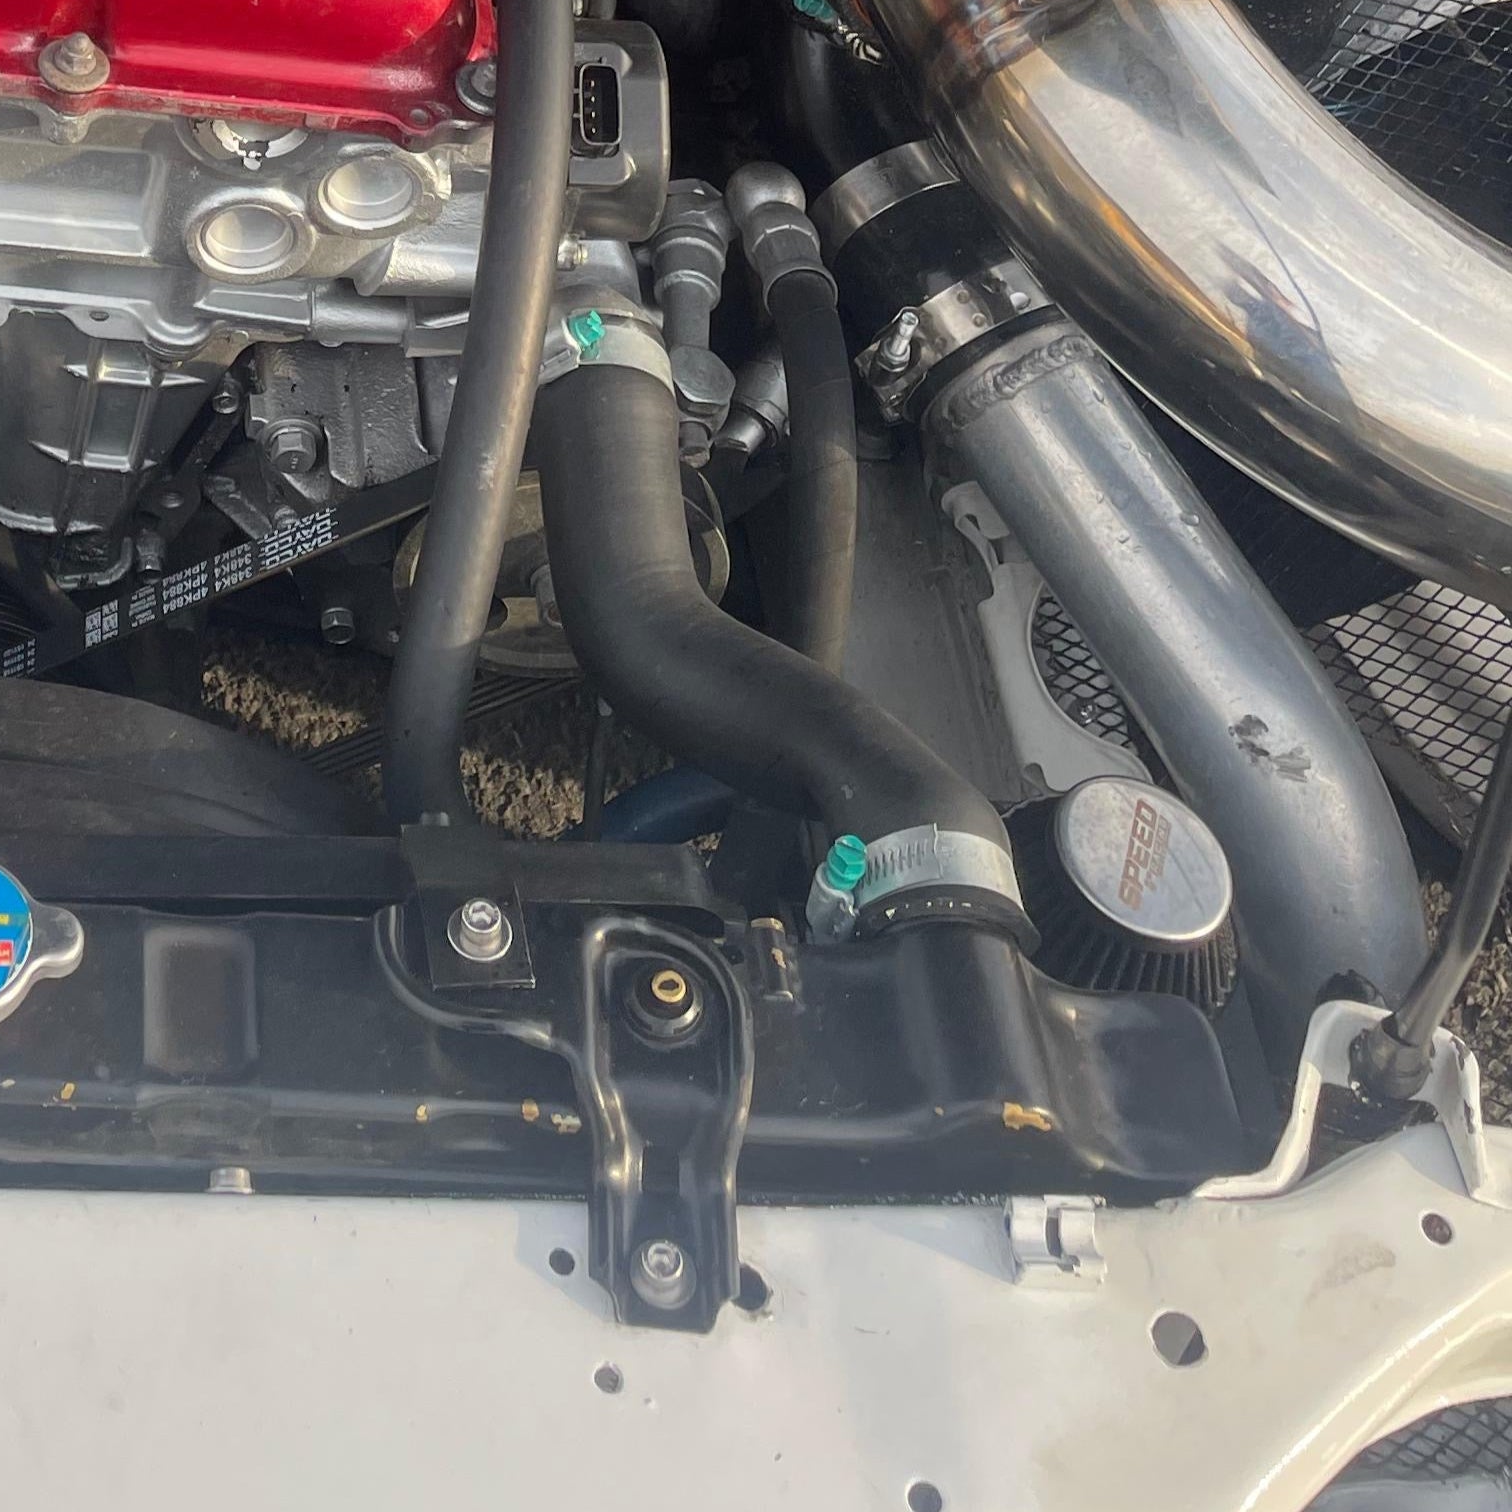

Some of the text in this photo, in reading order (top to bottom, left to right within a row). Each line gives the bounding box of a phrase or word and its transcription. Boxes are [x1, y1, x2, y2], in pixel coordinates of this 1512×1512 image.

[261, 519, 336, 557] DAYCO
[262, 531, 337, 570] DAYCO
[1118, 799, 1157, 910] SPEED
